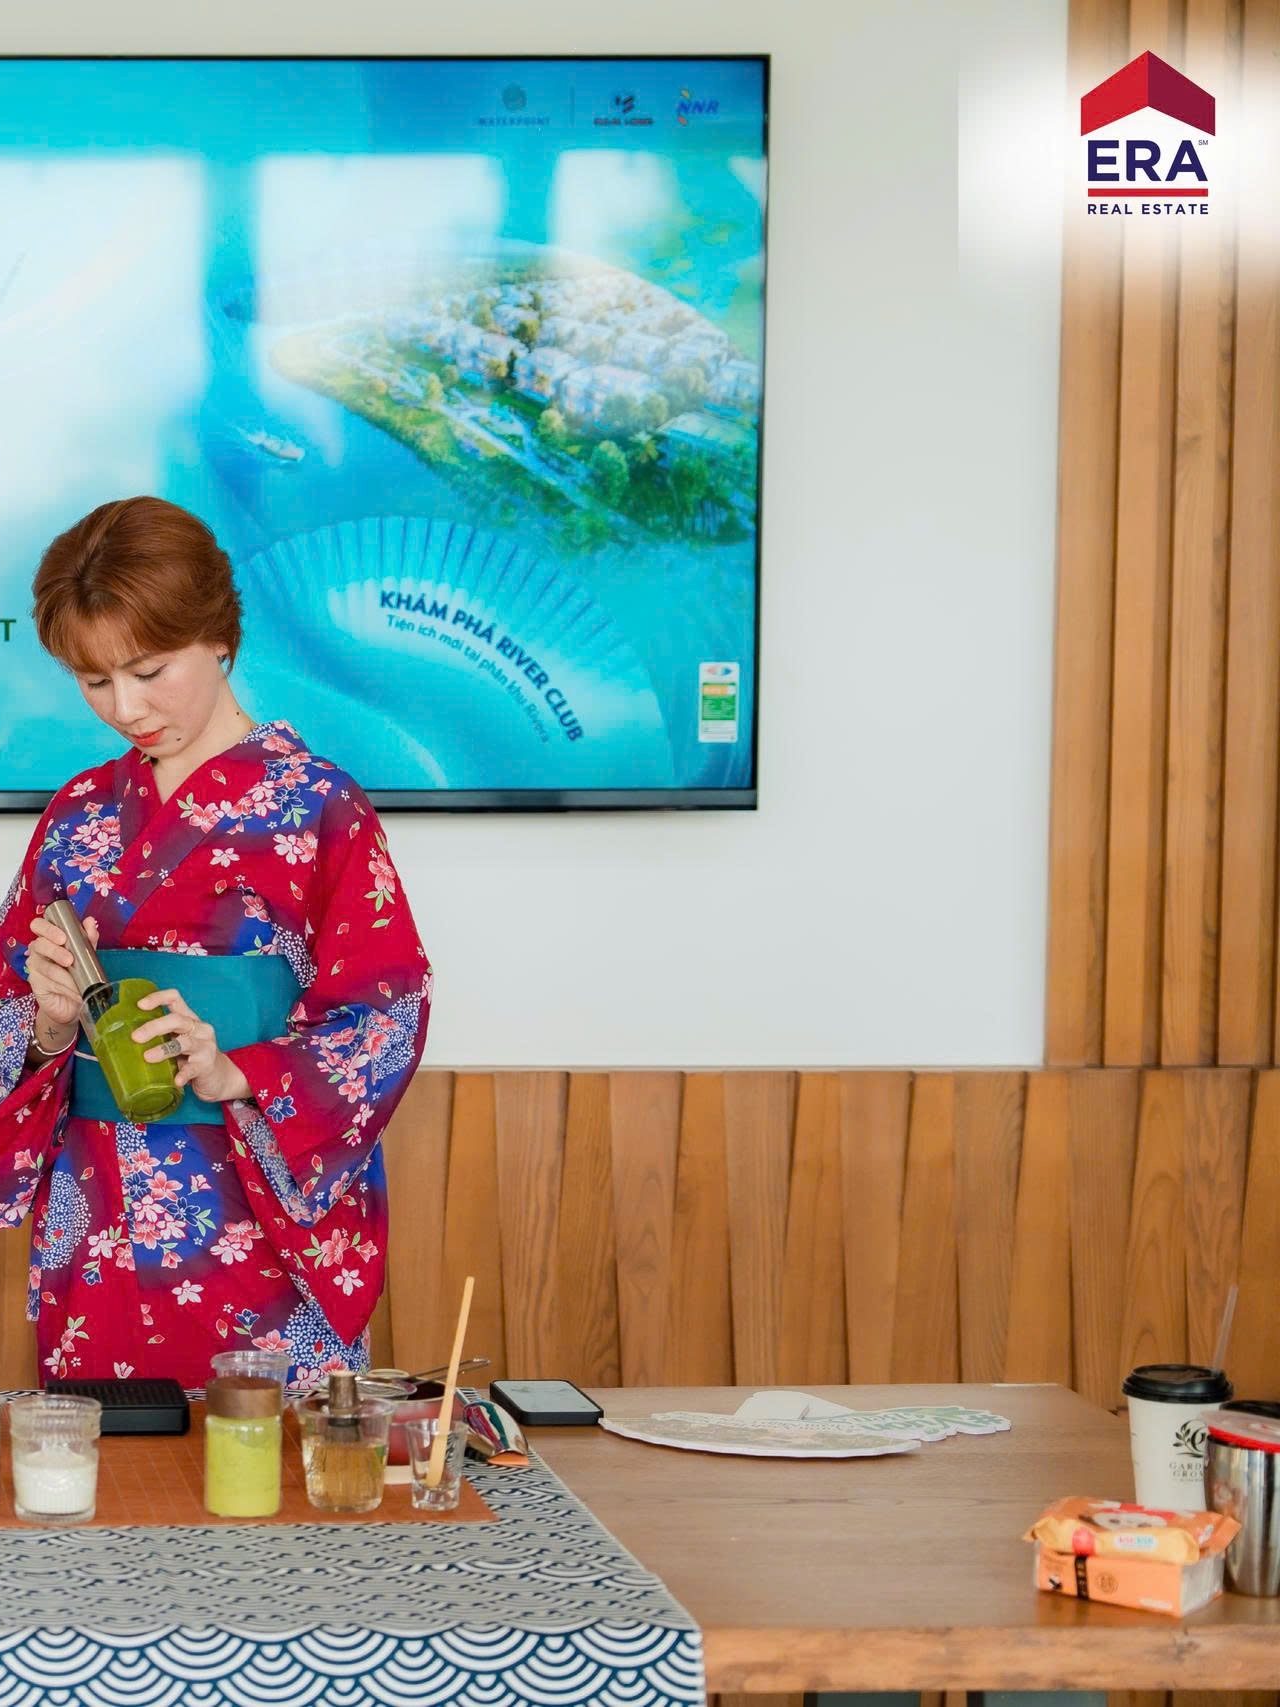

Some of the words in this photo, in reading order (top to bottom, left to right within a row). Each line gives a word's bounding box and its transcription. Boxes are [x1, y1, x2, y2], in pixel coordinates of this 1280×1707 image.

[379, 590, 449, 621] KHÁM
[451, 609, 497, 645] PHÁ
[496, 635, 550, 691] RIVER
[544, 687, 585, 742] CLUB
